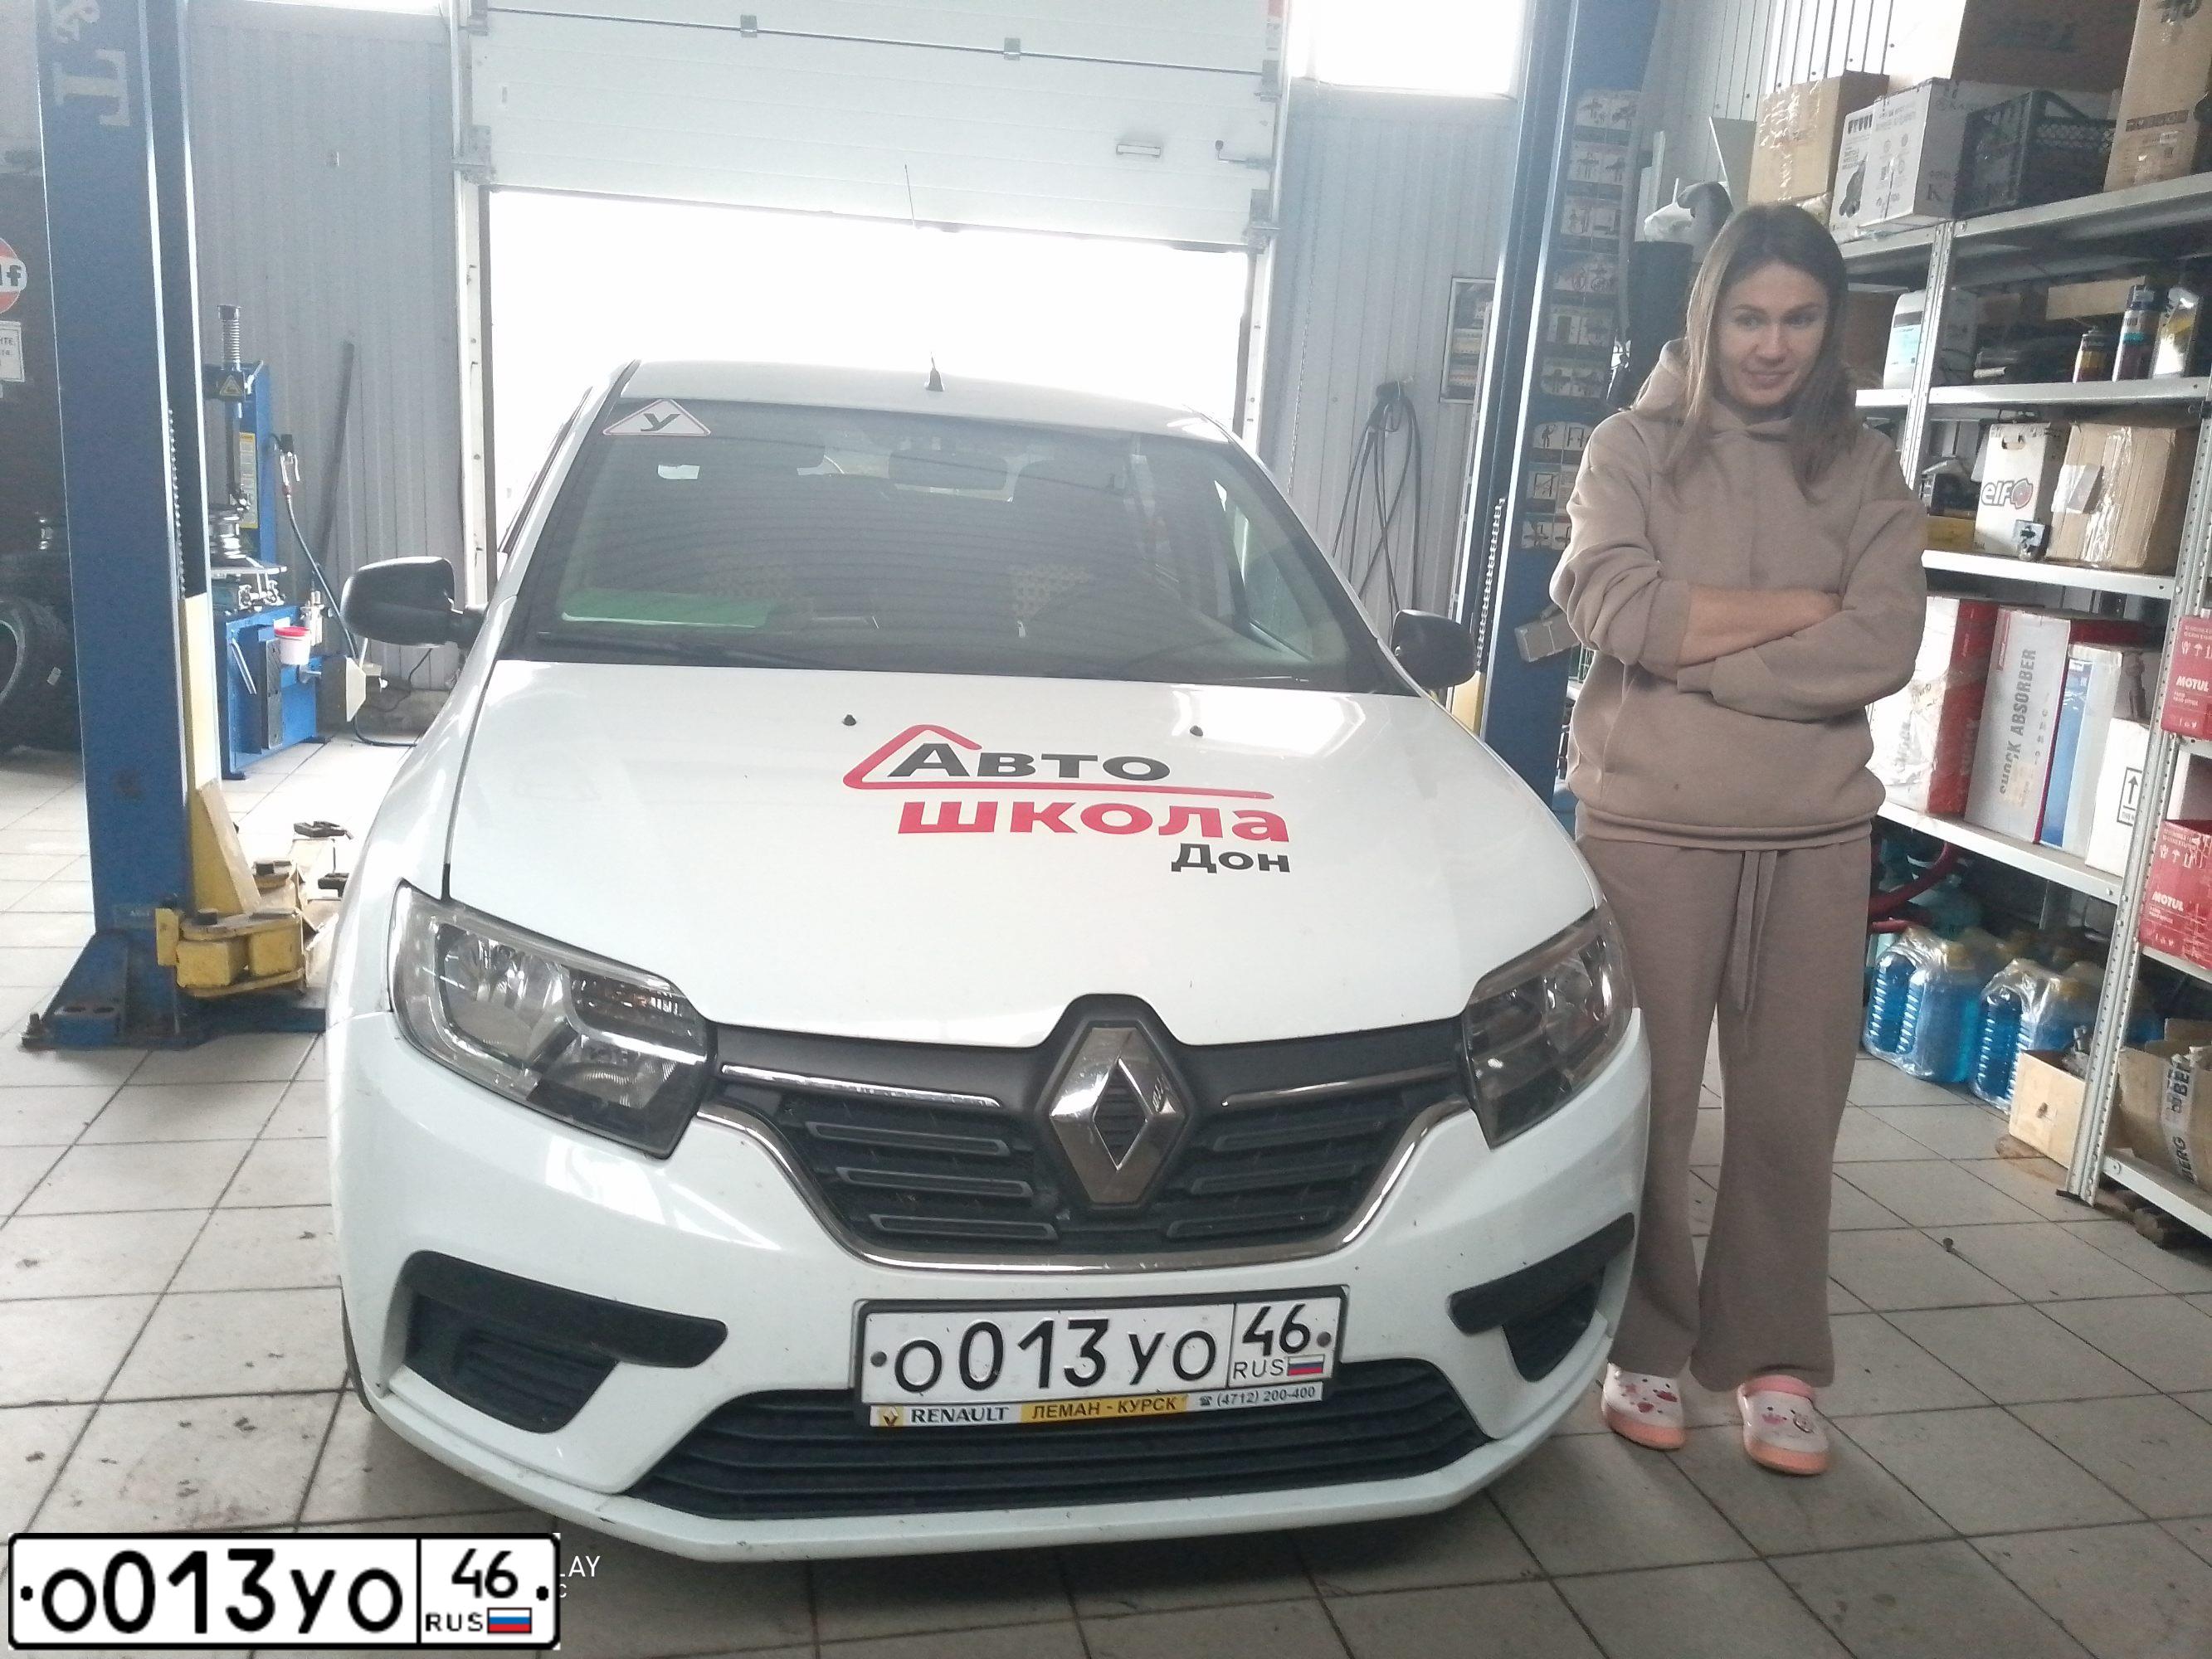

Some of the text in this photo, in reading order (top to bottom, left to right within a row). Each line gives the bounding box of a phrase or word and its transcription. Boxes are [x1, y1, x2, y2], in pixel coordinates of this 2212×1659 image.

[640, 413, 681, 432] У
[1981, 479, 2015, 507] elf
[2010, 648, 2037, 737] ABSORBER
[2175, 675, 2210, 693] MOTUL
[899, 801, 1289, 843] школа
[1172, 843, 1290, 873] Дон
[2152, 891, 2184, 912] MOTUL
[1241, 1303, 1312, 1358] 46
[1235, 1357, 1284, 1380] RUS
[911, 1406, 1010, 1423] RENAULT
[1032, 1401, 1100, 1419] ЛЕМАН
[1118, 1397, 1178, 1413] КУРСК
[1216, 1390, 1259, 1408] (4712)
[1264, 1386, 1316, 1403] 200-400
